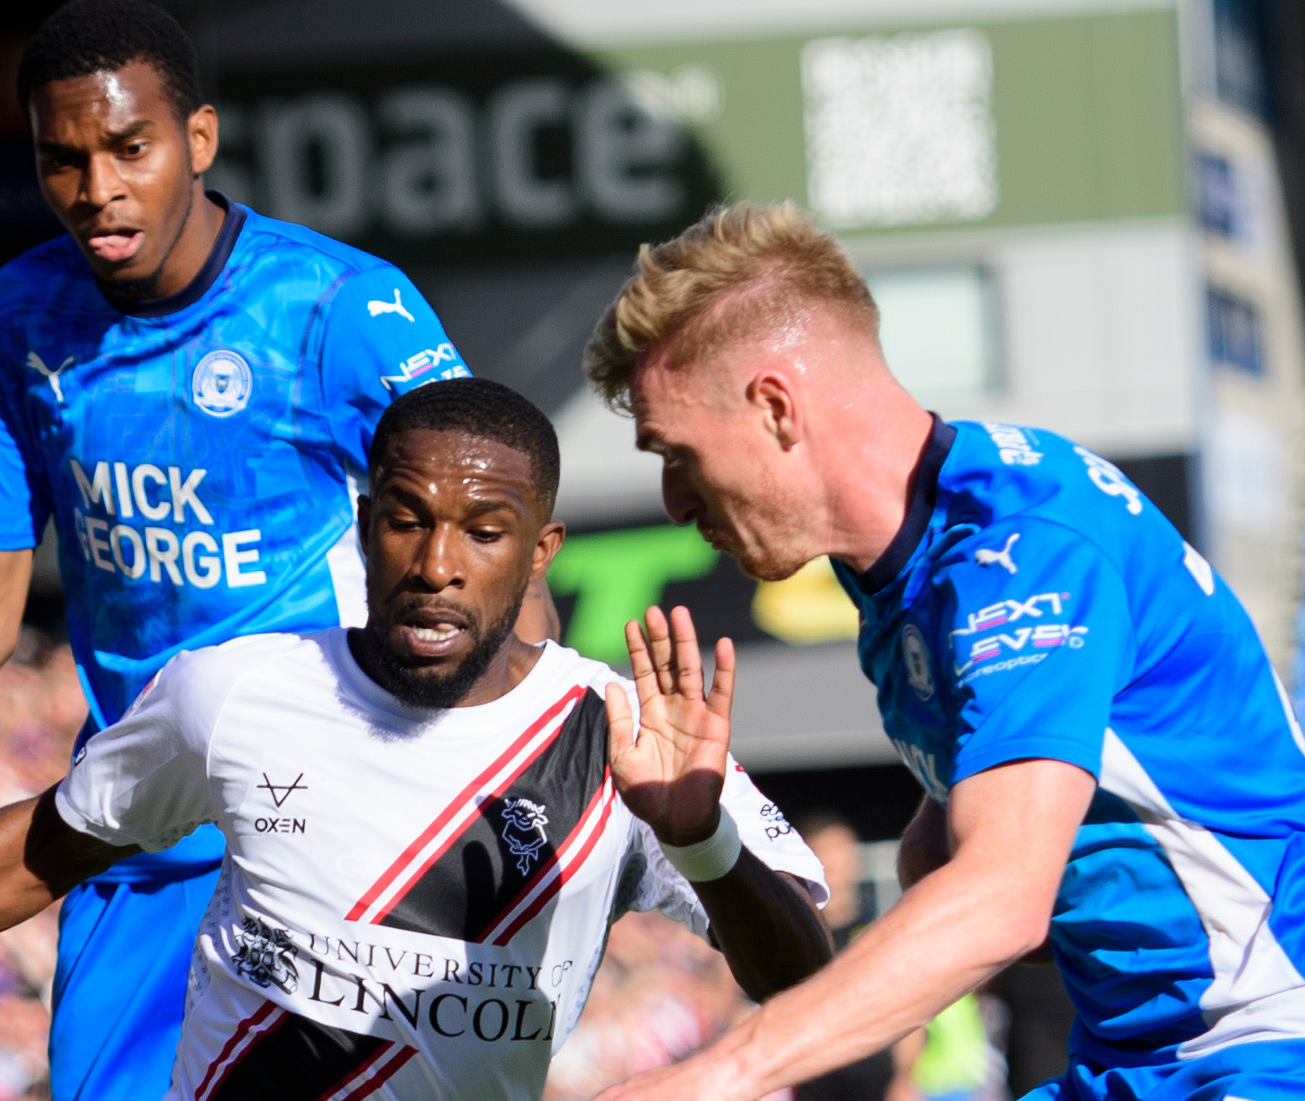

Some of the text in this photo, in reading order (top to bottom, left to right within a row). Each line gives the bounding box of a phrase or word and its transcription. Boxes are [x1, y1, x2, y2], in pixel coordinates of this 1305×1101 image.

[69, 458, 214, 525] MICK
[74, 506, 268, 590] GEORGE
[255, 816, 306, 834] OXEN
[308, 933, 542, 990] UNIVERSITY
